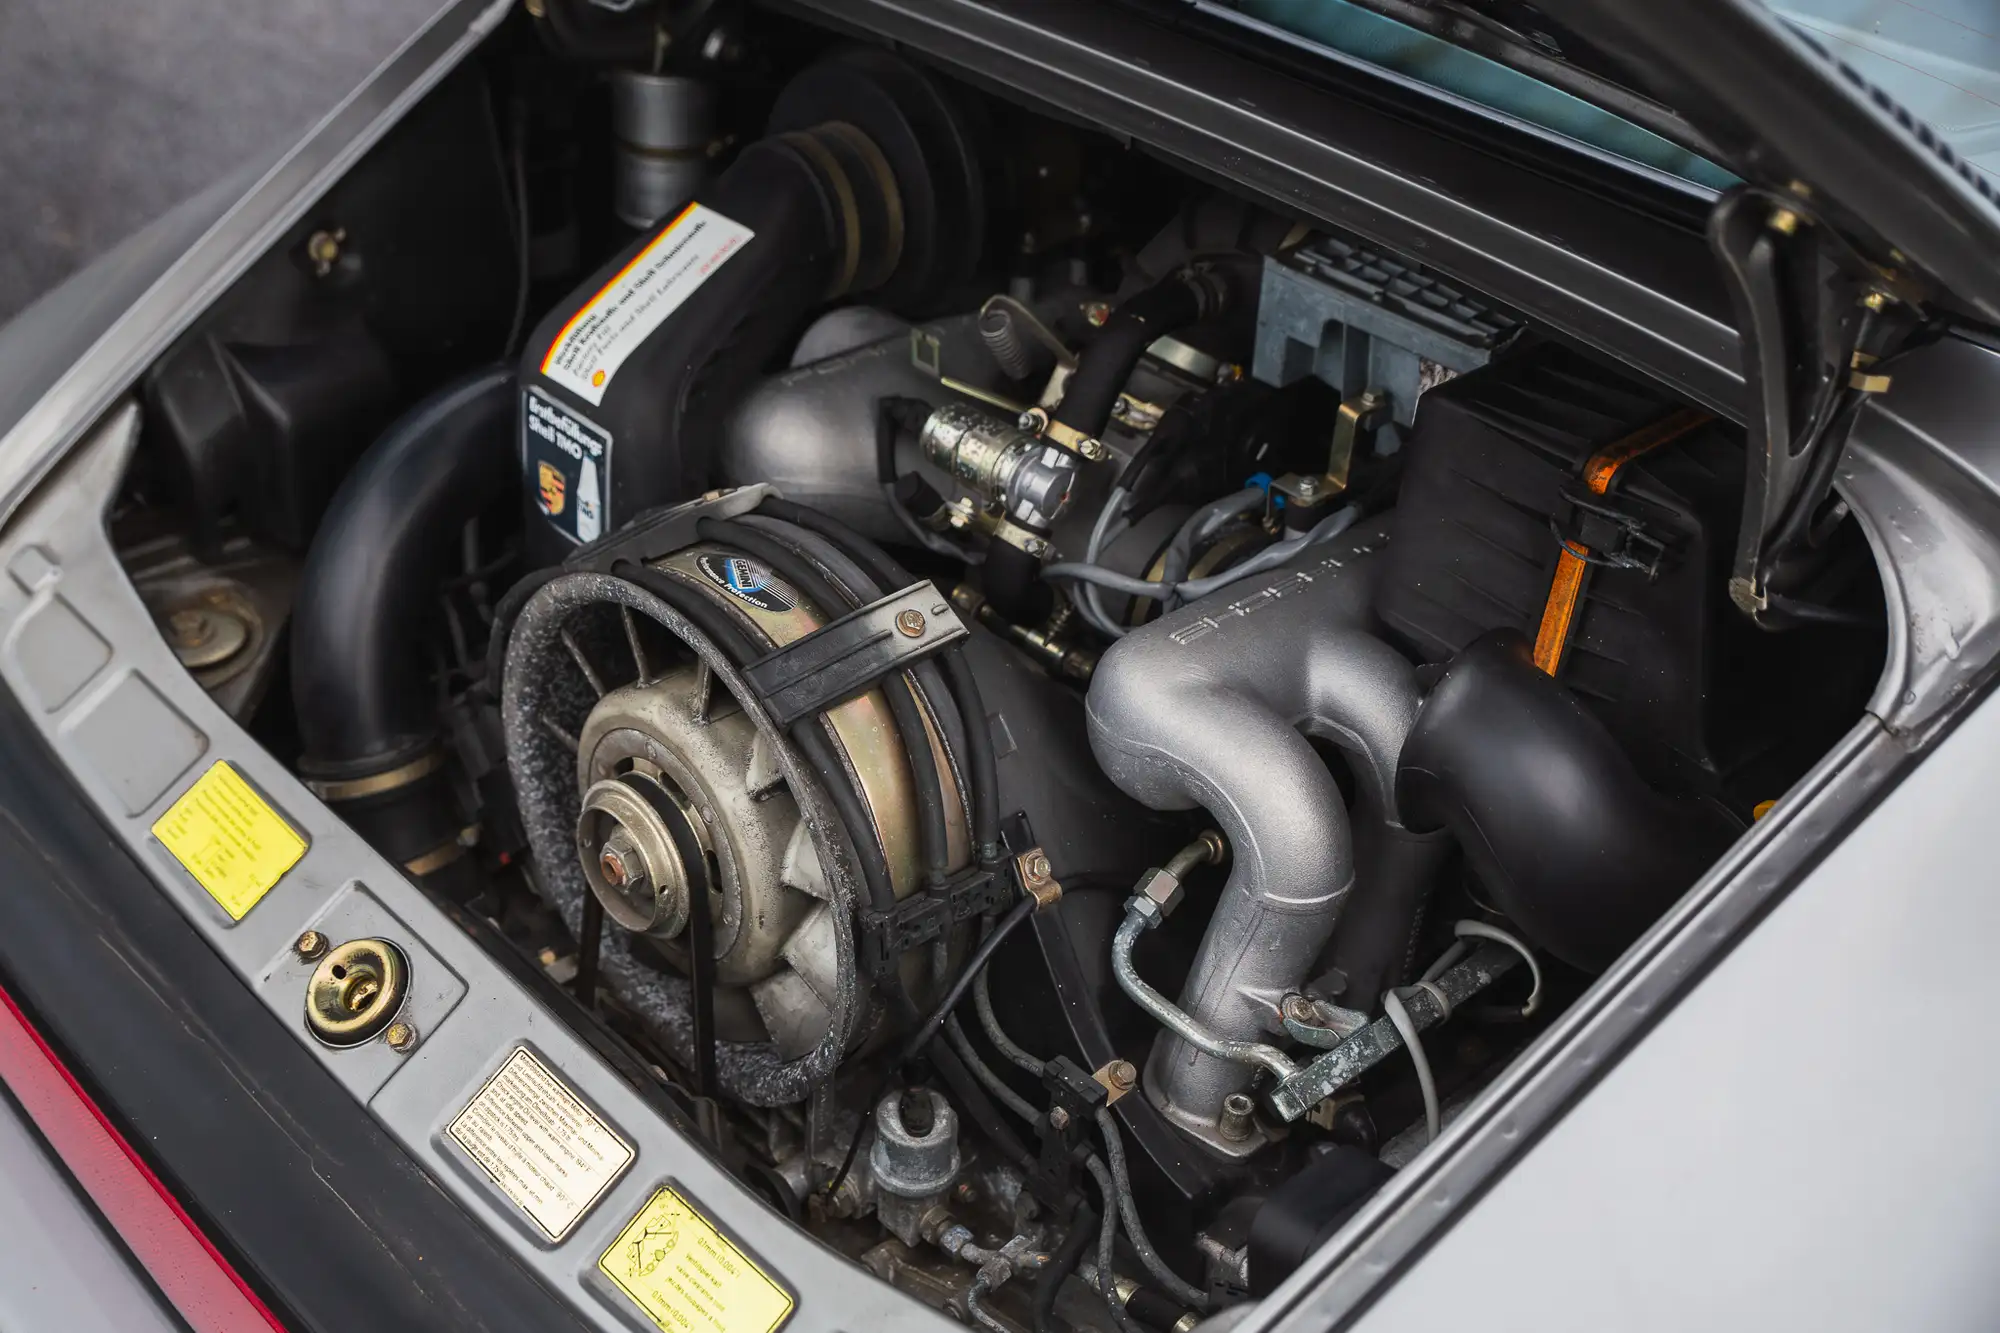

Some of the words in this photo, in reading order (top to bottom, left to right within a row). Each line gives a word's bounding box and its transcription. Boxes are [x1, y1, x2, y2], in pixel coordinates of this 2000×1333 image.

[529, 413, 556, 443] Shell
[735, 560, 753, 588] GEMINI
[724, 583, 768, 609] Protection
